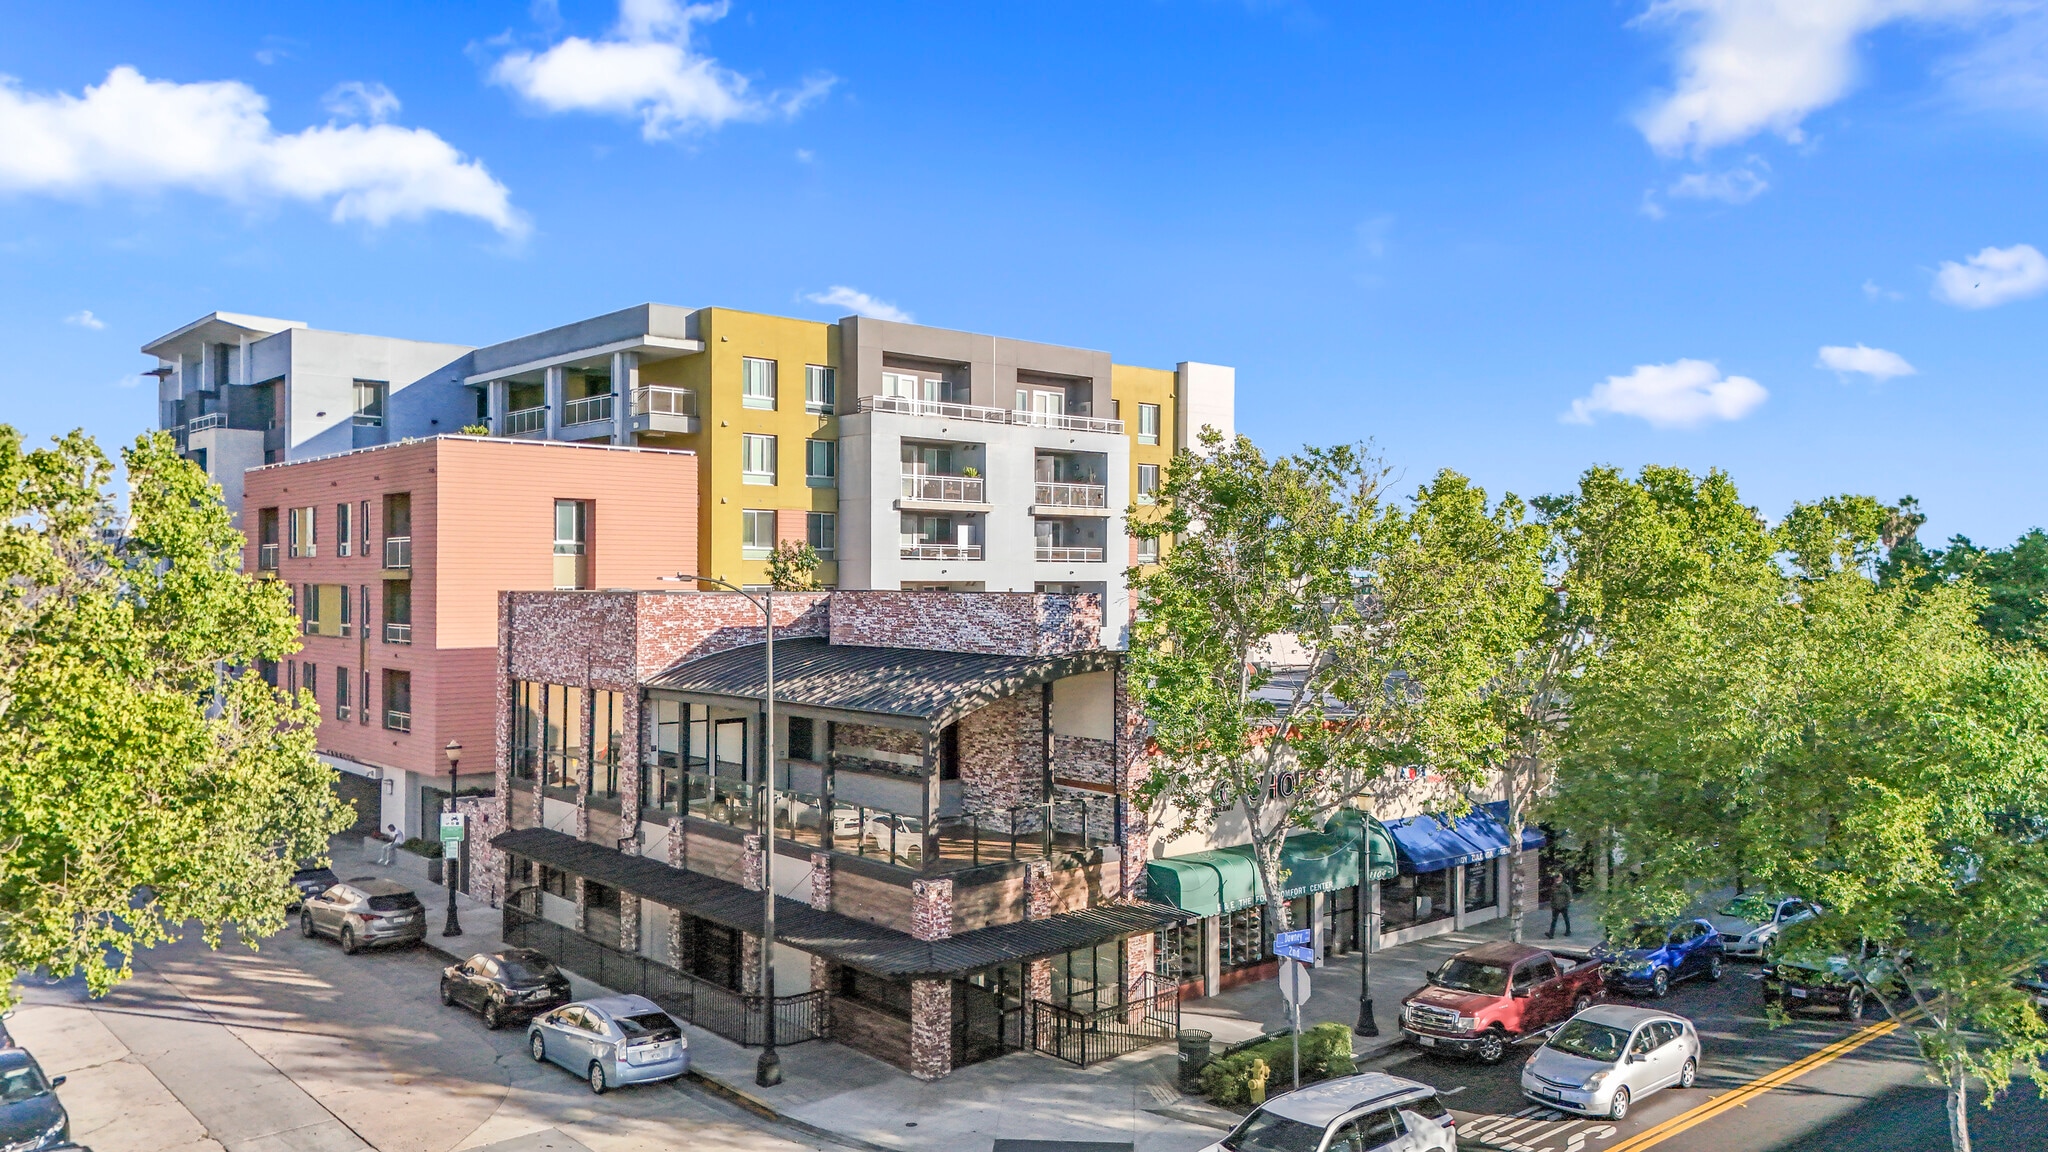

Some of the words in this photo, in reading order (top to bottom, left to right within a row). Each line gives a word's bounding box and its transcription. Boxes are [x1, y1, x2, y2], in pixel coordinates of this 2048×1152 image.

[1238, 897, 1252, 907] THE
[1280, 885, 1306, 898] OMFORT
[1309, 880, 1333, 893] CENTER
[1284, 931, 1303, 943] Downey
[1288, 945, 1300, 958] 2nd
